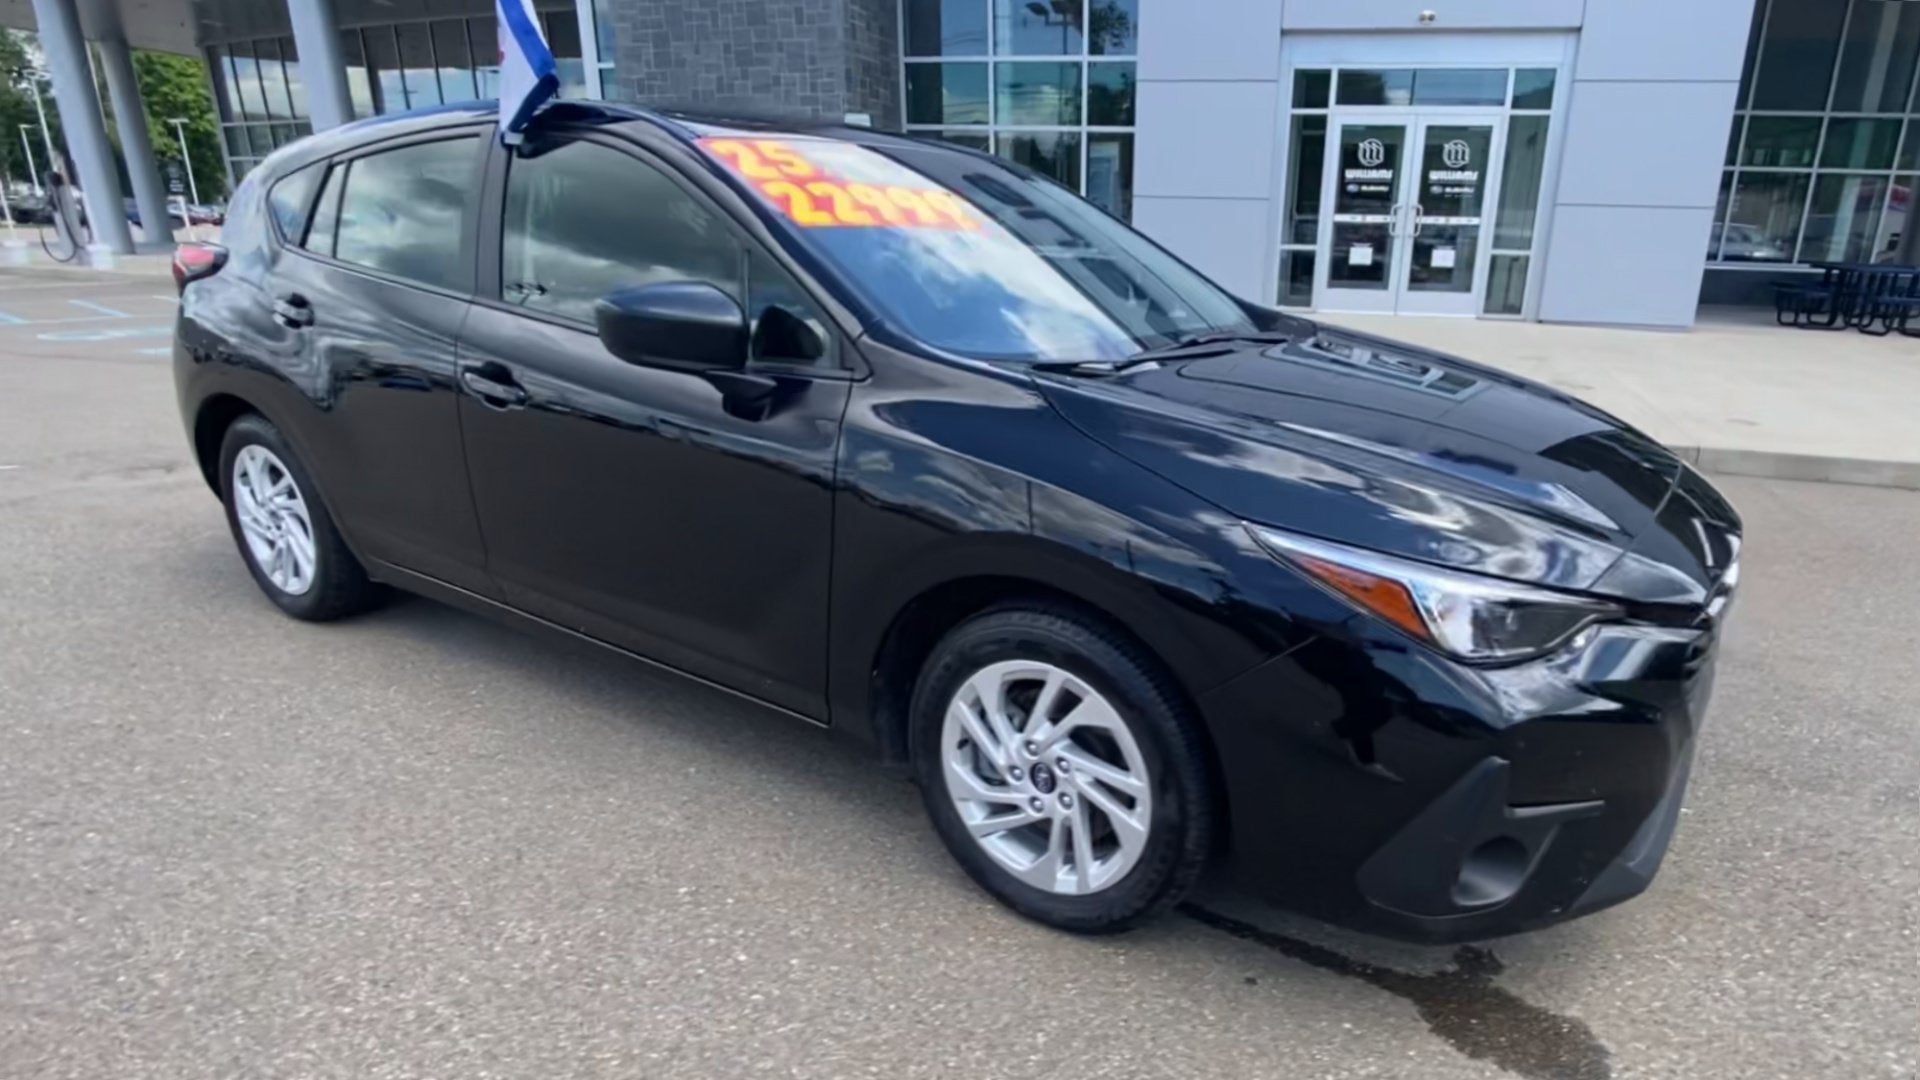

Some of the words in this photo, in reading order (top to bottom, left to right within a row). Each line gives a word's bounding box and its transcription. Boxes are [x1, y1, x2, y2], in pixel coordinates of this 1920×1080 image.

[708, 139, 814, 179] 25
[1345, 169, 1393, 179] WILLIAMS
[1429, 170, 1479, 180] WILLIAMS
[757, 179, 980, 228] 22999
